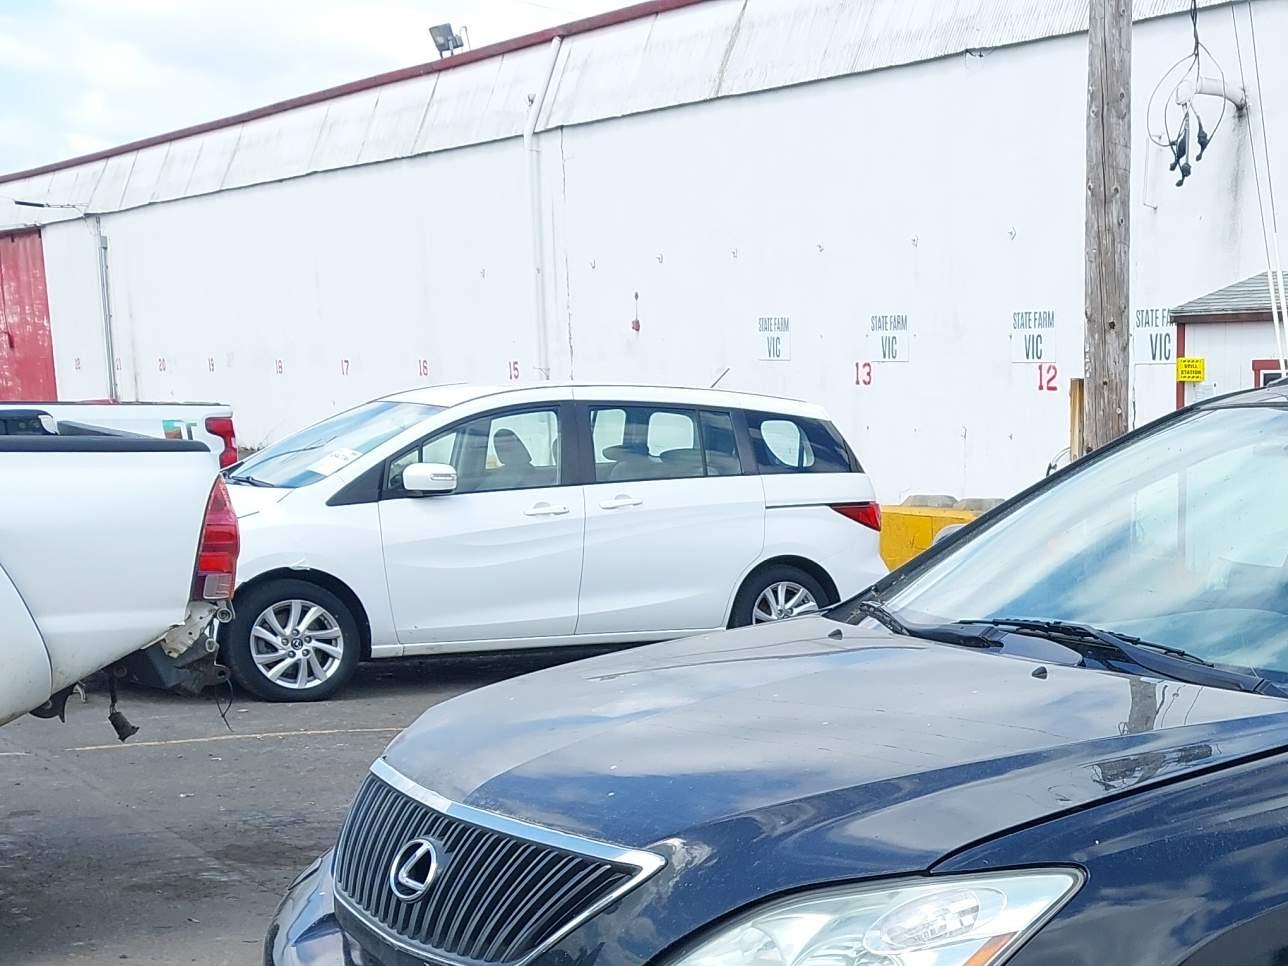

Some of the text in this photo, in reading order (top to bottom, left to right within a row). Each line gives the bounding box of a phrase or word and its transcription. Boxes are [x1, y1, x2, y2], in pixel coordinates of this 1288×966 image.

[758, 317, 790, 332] STATE FARM
[871, 314, 908, 331] STATE FARM
[1013, 311, 1055, 329] STATE FARM
[1136, 309, 1160, 328] STATE
[767, 336, 781, 358] VIC
[881, 335, 897, 359] VIC
[1024, 334, 1043, 360] VIC
[1150, 333, 1171, 360] VIC
[341, 360, 350, 376] 17
[418, 359, 429, 376] 16
[509, 361, 520, 380] 15
[855, 362, 872, 385] 13
[1038, 365, 1058, 391] 12
